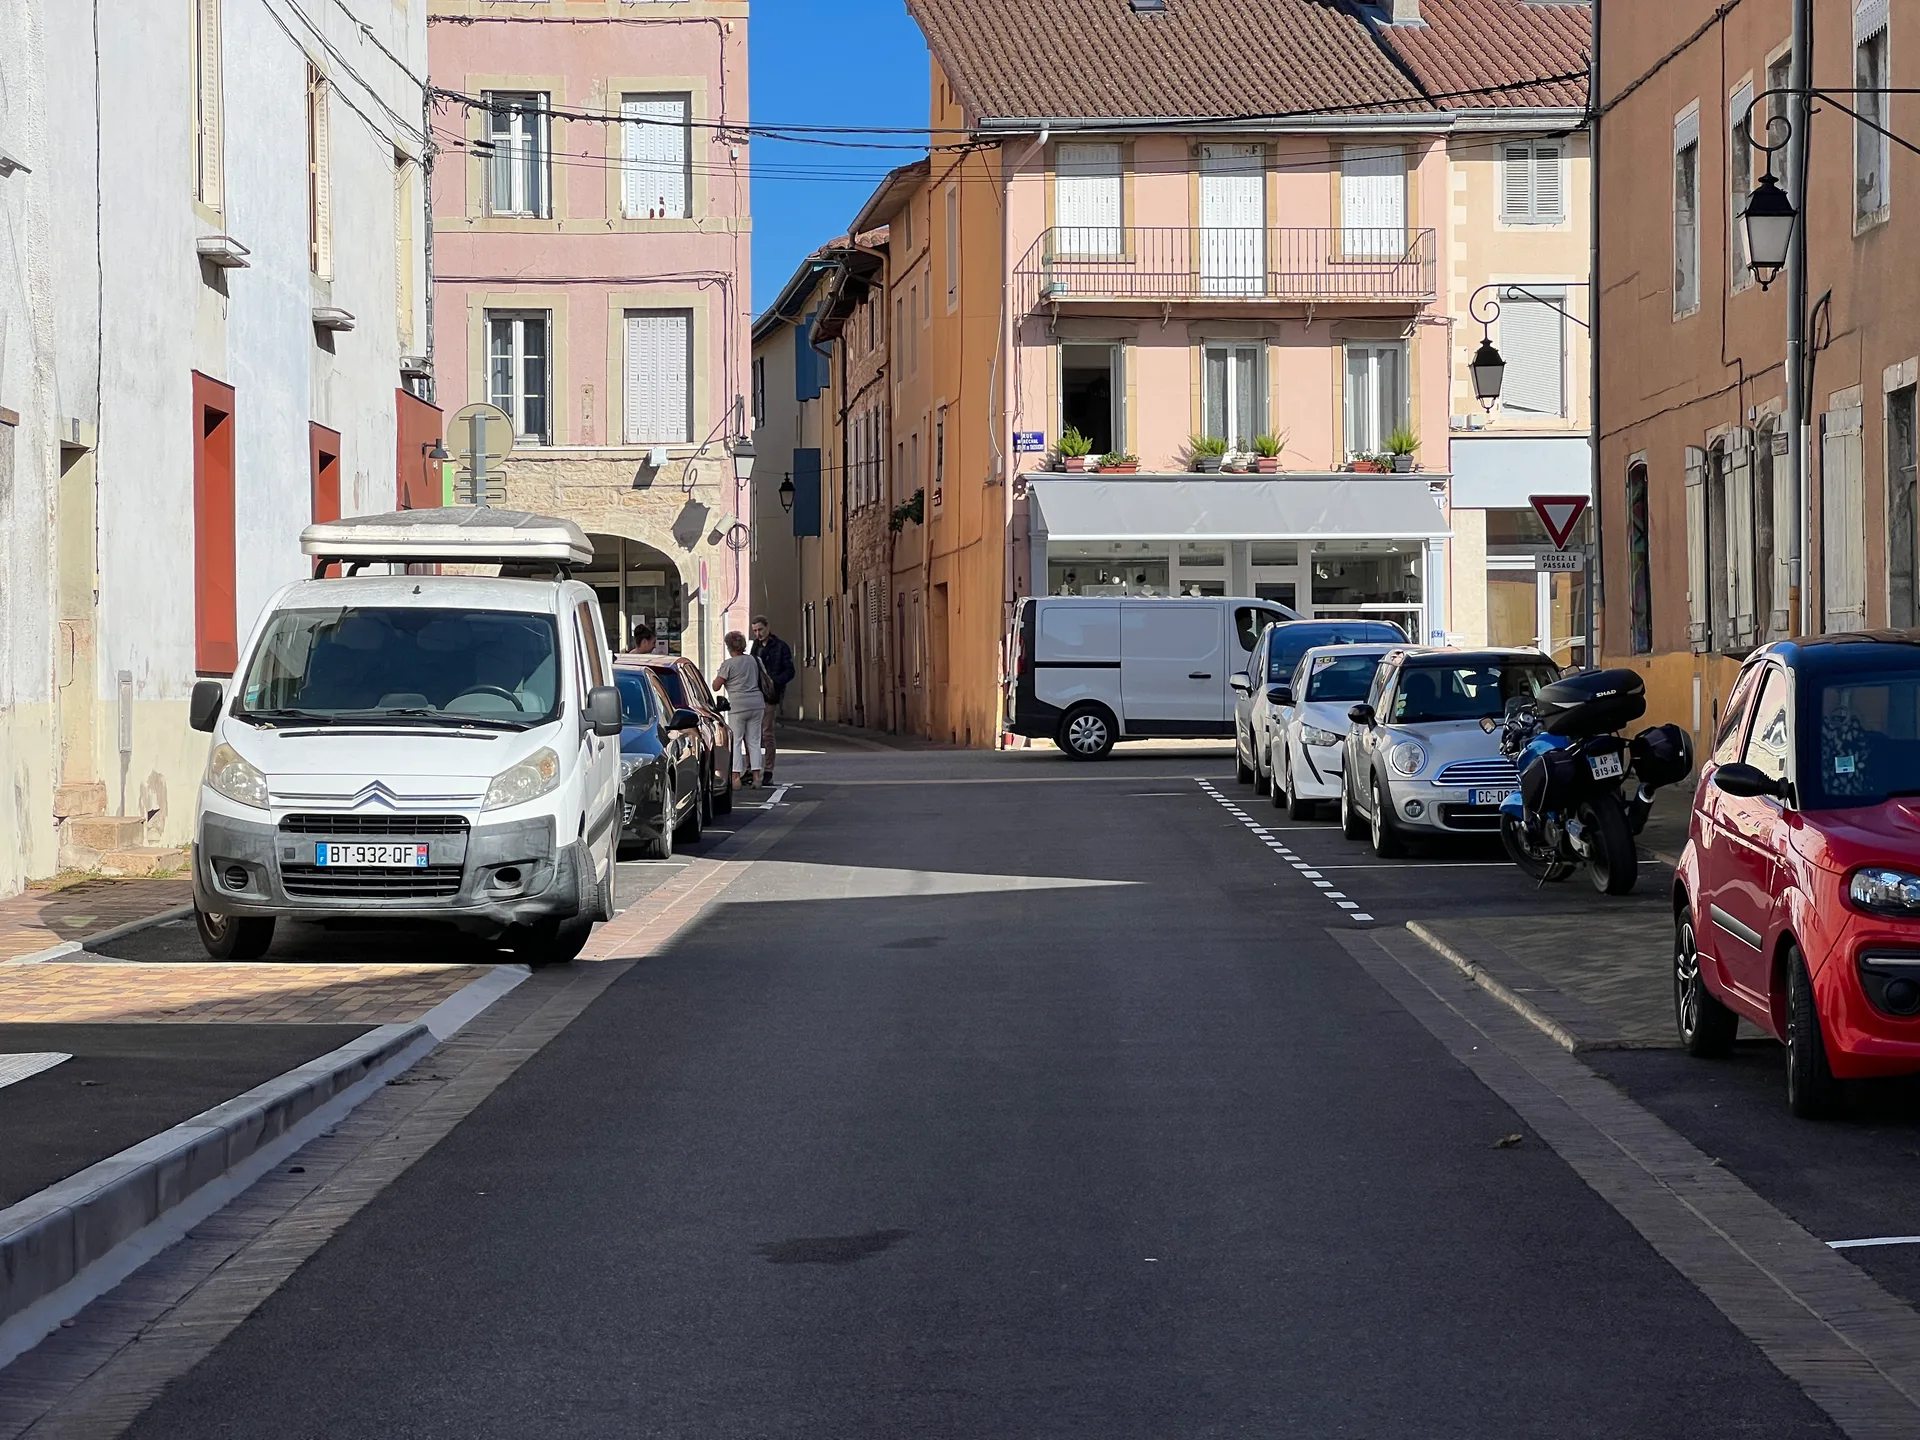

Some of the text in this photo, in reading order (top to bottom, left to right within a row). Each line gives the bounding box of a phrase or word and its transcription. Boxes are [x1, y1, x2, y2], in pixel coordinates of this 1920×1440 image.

[1541, 554, 1565, 562] CÉDEZ
[1595, 689, 1617, 698] SHAD
[1594, 764, 1620, 778] 819-AR
[330, 846, 413, 864] BT-932-QF
[417, 856, 426, 865] 12
